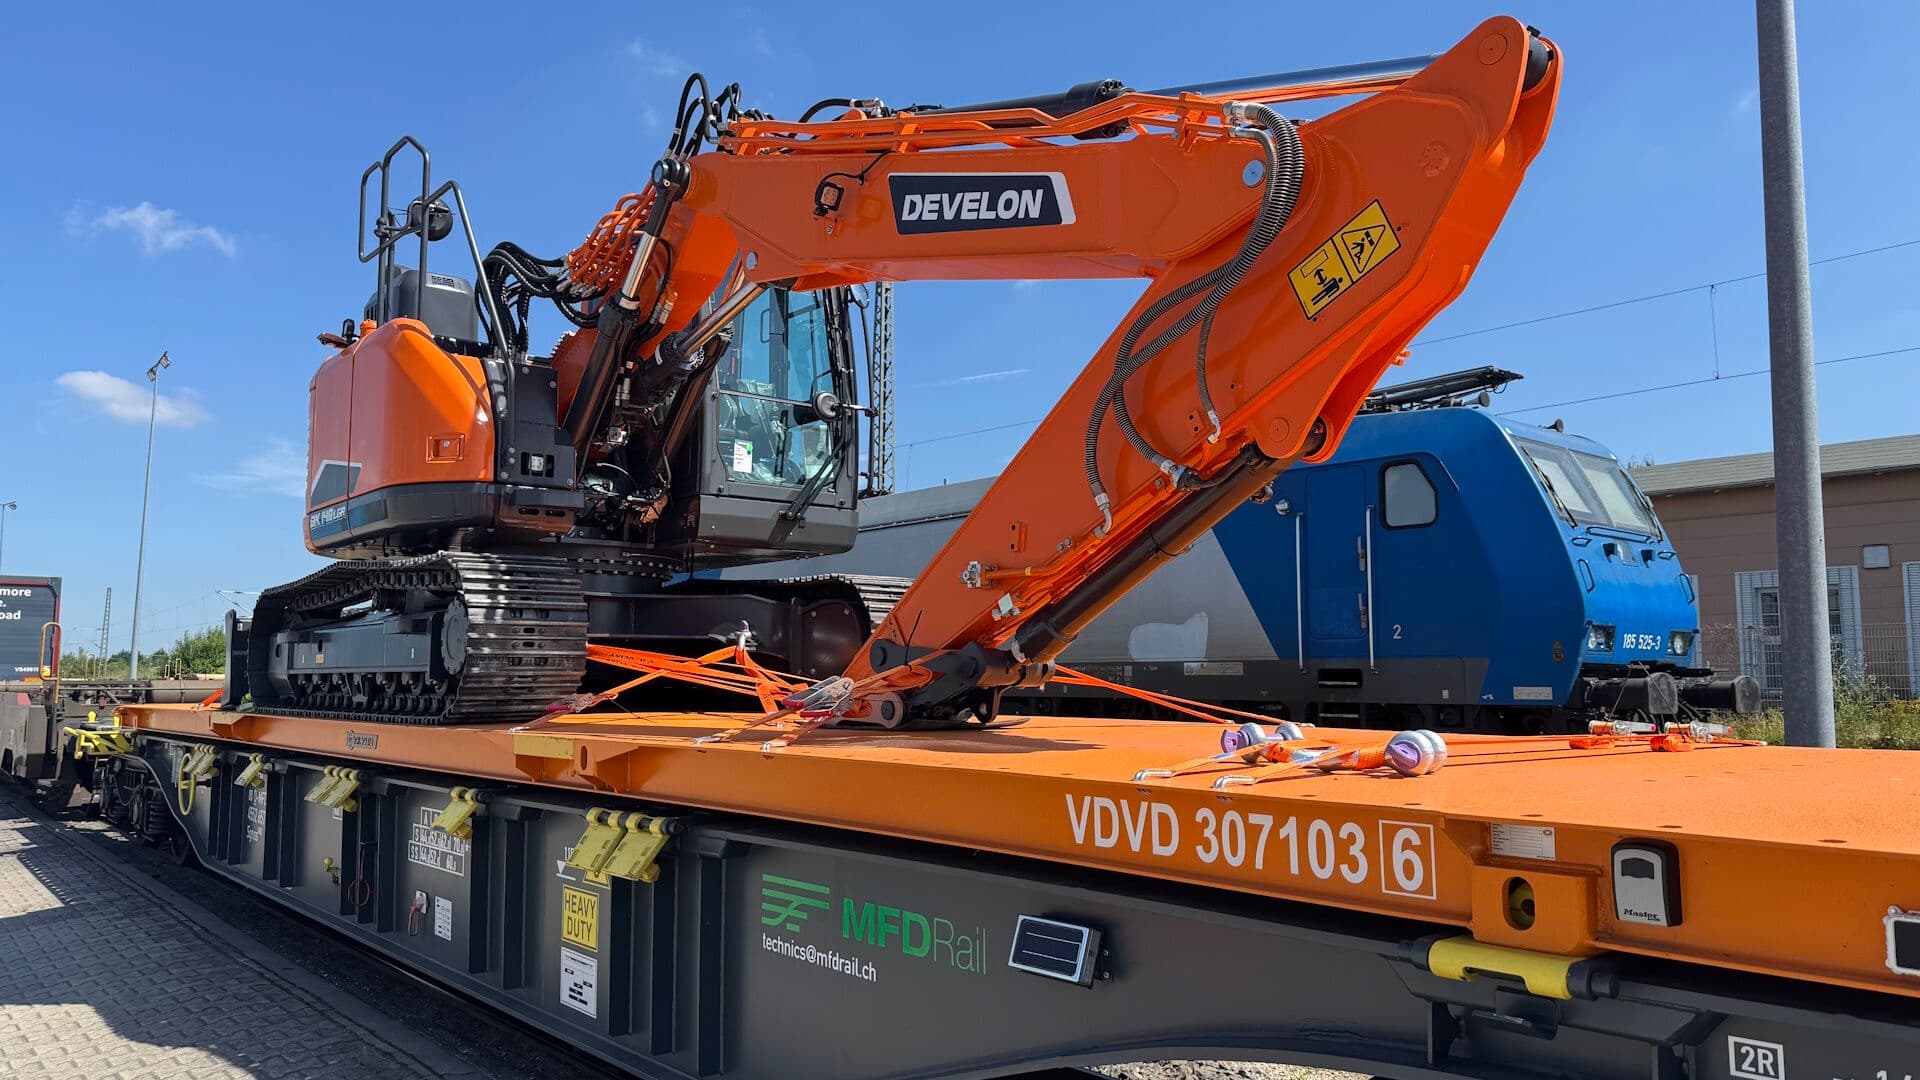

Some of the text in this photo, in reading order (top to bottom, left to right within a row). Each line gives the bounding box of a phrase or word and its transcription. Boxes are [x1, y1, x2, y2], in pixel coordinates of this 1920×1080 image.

[901, 188, 1044, 222] DEVELON
[1392, 624, 1402, 640] 2
[1622, 633, 1661, 650] 185 525-3
[414, 828, 420, 842] S
[1065, 793, 1180, 857] VDVD
[1195, 807, 1369, 884] 307103
[1392, 827, 1424, 892] 6
[410, 845, 419, 860] SS
[564, 892, 596, 919] HEAVY
[1623, 908, 1658, 919] Master
[567, 915, 592, 942] DUTY
[762, 932, 877, 983] technics@mfdrail.ch
[1740, 1045, 1776, 1076] 2R
